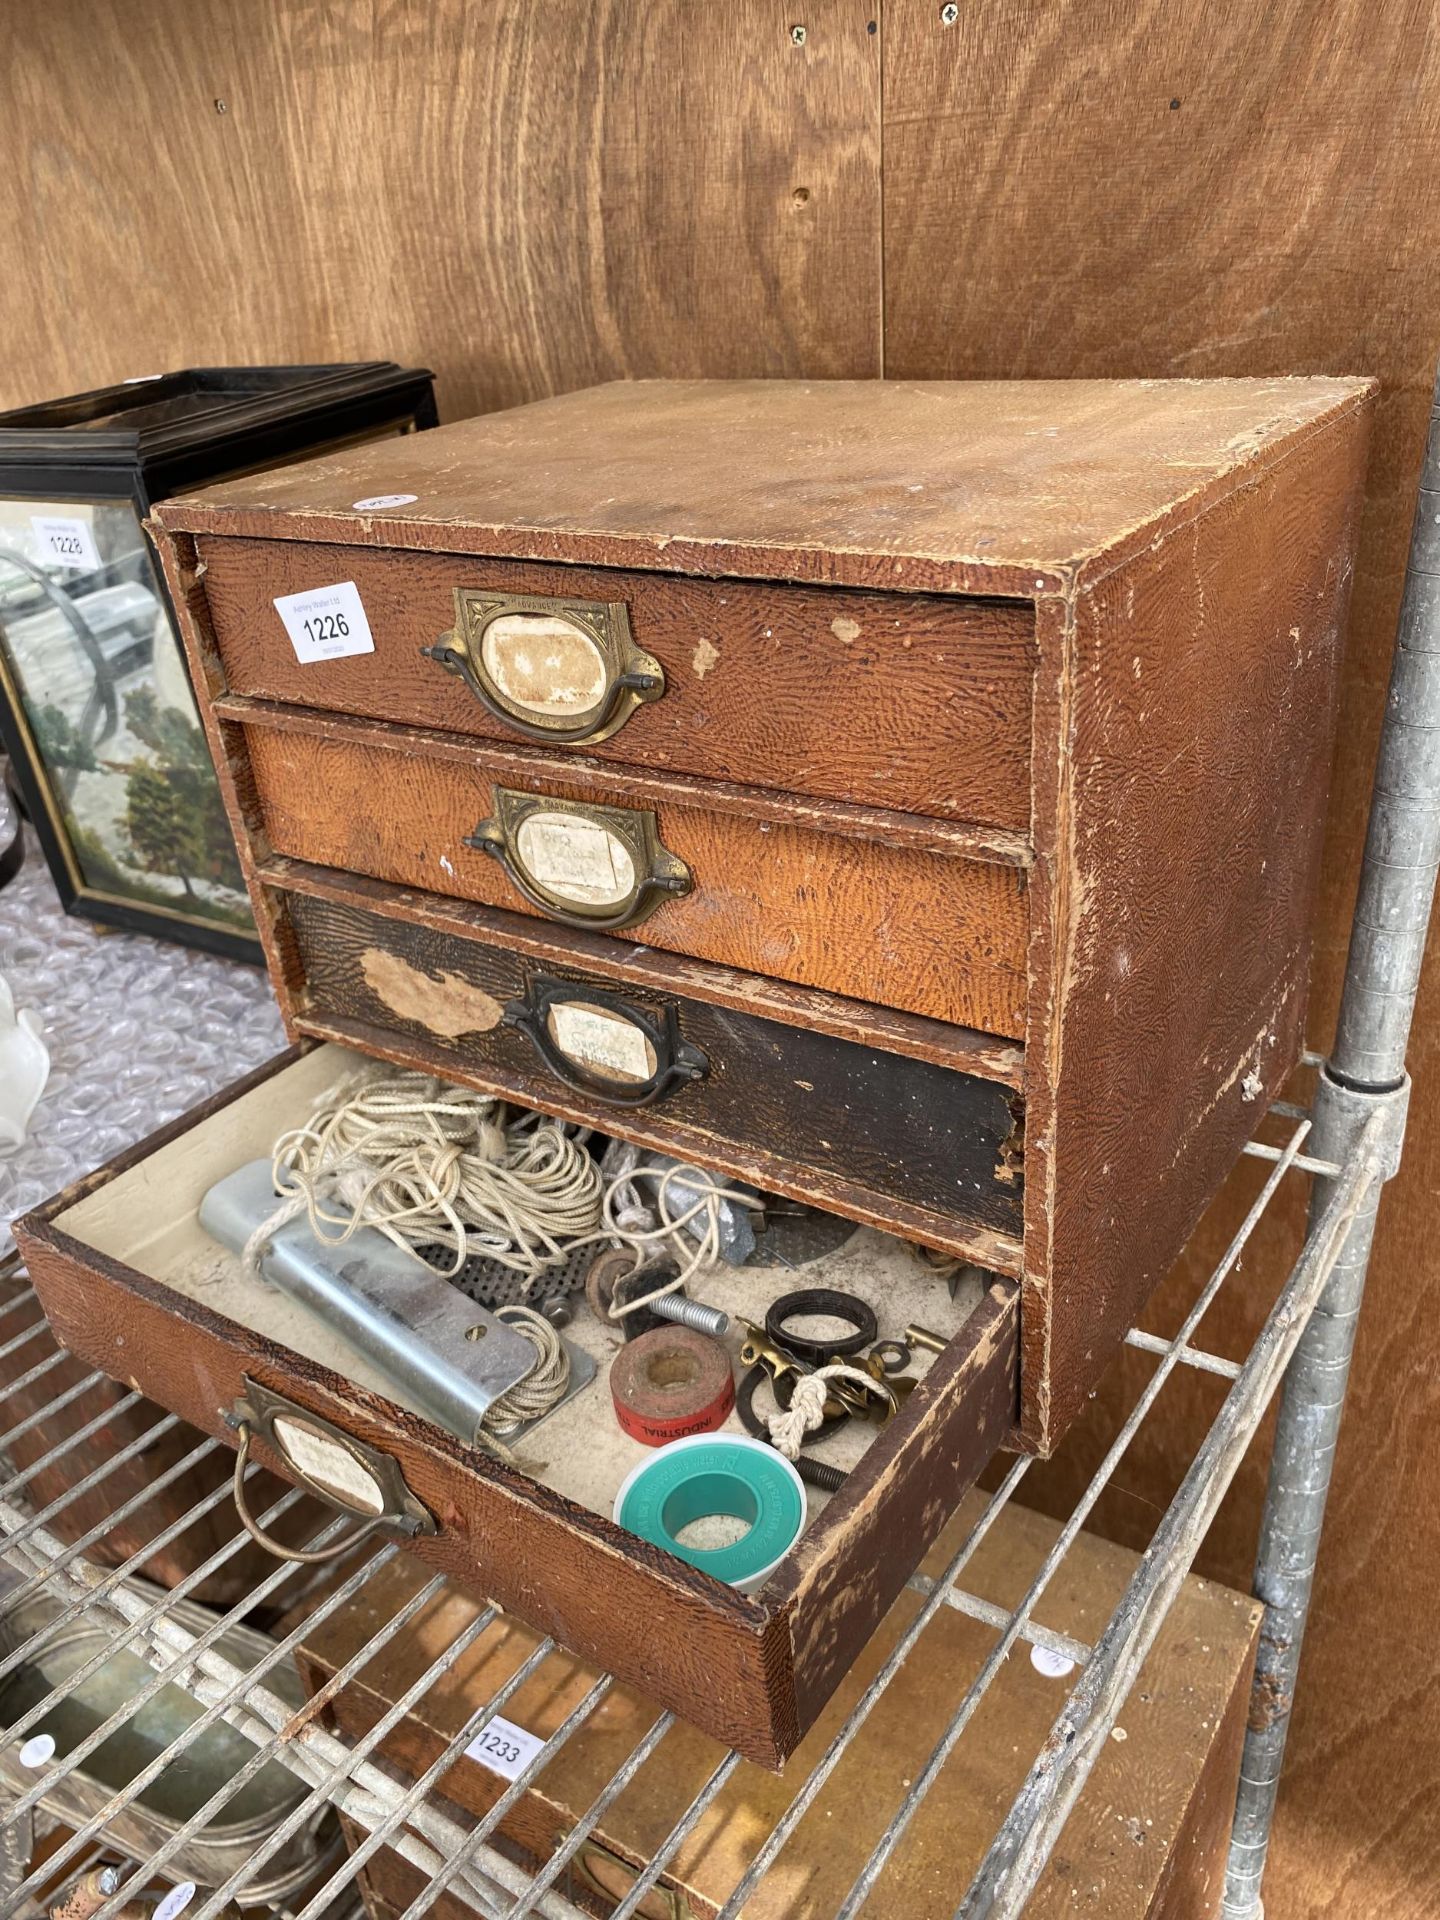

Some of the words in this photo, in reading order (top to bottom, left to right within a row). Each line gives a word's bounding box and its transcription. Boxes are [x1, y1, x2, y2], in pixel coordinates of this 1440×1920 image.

[50, 537, 82, 554] 1228
[304, 613, 350, 642] 1226
[641, 1416, 712, 1438] INDUSTRIAL
[479, 1732, 520, 1763] 1233
